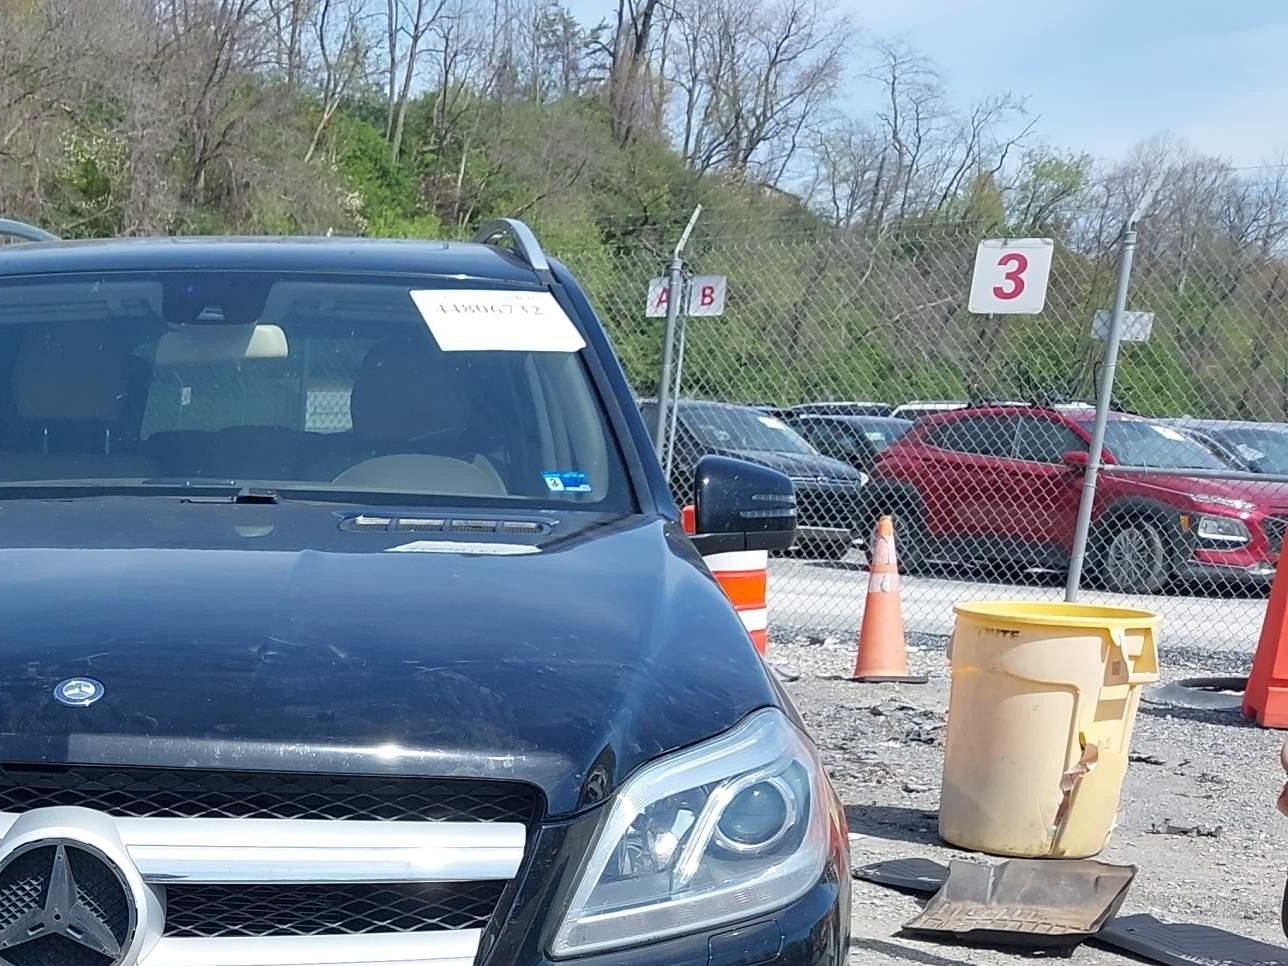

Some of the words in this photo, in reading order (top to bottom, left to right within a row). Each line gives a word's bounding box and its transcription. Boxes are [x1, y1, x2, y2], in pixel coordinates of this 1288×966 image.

[993, 253, 1028, 300] 3
[656, 287, 670, 308] A
[701, 286, 715, 306] B
